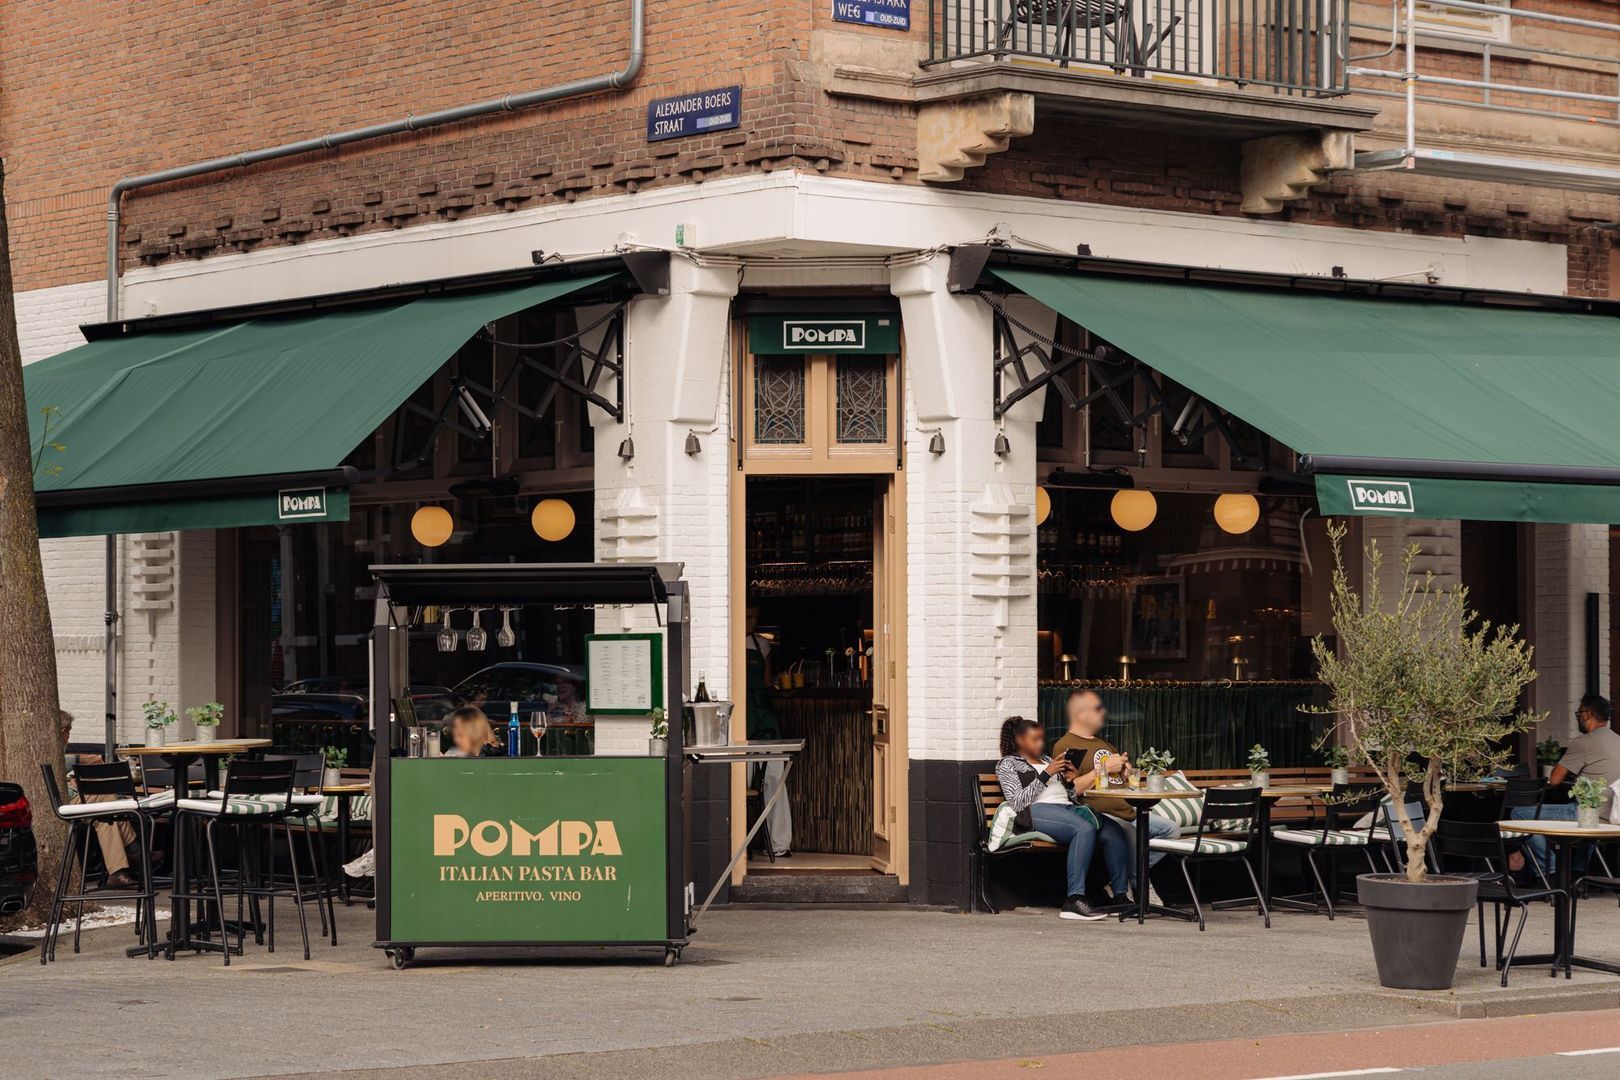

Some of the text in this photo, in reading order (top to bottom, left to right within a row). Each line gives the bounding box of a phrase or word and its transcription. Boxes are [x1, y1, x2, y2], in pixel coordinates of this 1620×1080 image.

[838, 2, 861, 18] WEG
[655, 92, 732, 118] ALEXANDER BOERS
[655, 118, 684, 135] STRAAT
[791, 327, 857, 343] POMPA
[283, 495, 321, 512] POMPA
[1355, 487, 1407, 505] POMPA
[433, 814, 623, 857] POMPA
[439, 865, 617, 882] ITALIAN PASTA BAR
[475, 890, 581, 902] APERITIVO. VINO
